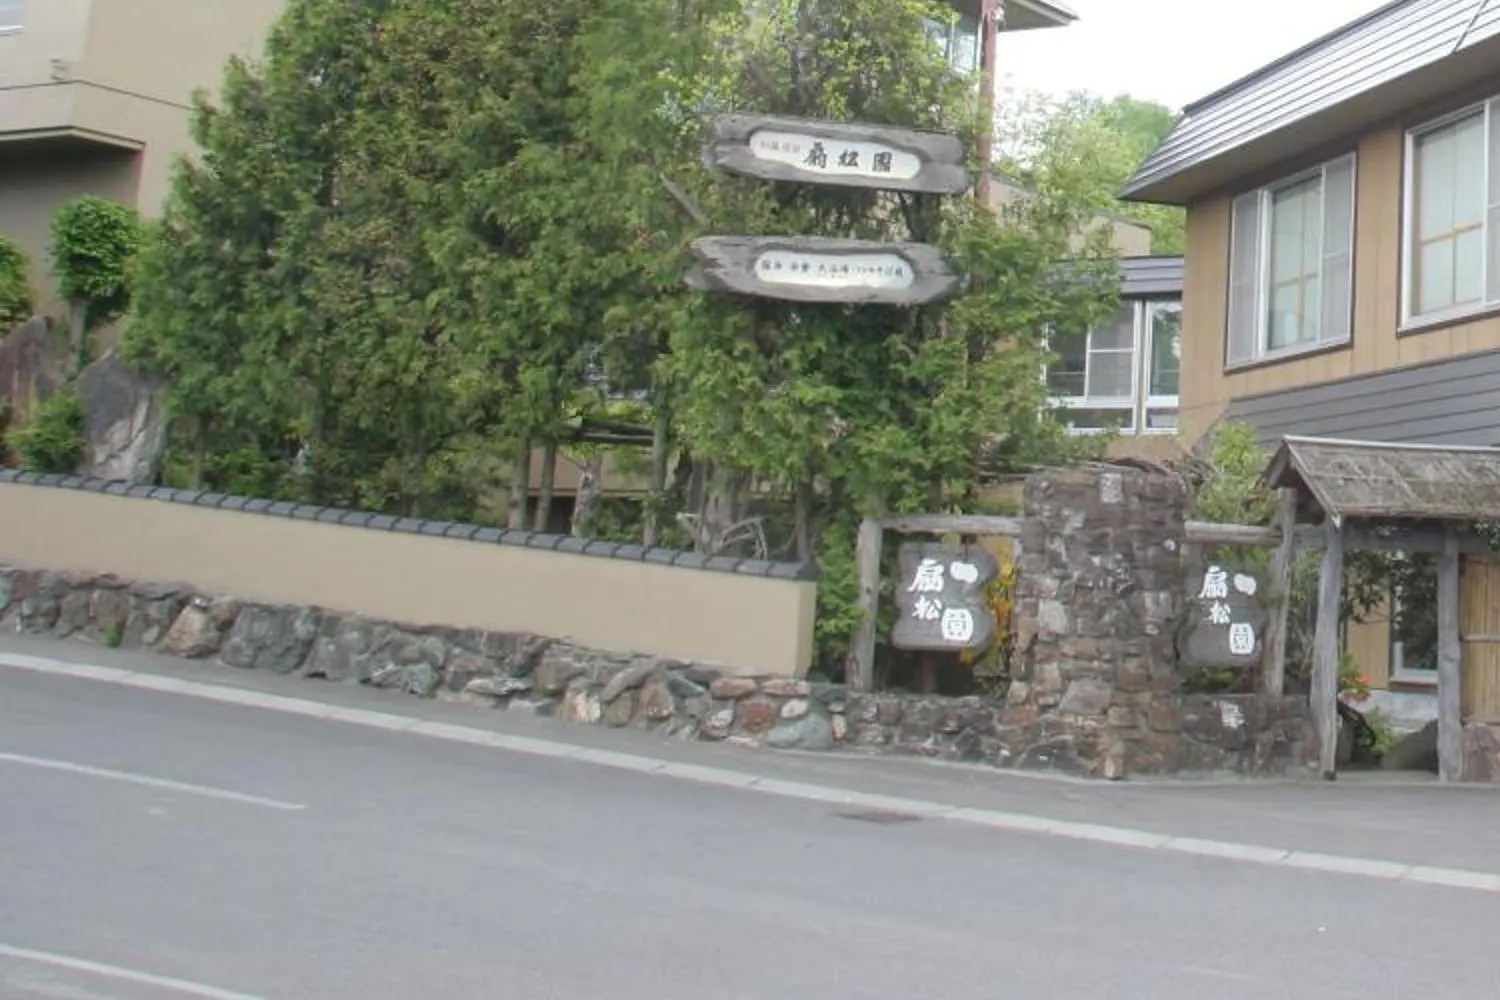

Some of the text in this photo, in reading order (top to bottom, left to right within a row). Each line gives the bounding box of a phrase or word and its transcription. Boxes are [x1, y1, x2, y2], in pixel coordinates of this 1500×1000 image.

[907, 558, 975, 641] 扇松園
[1198, 565, 1256, 655] 扇松園
